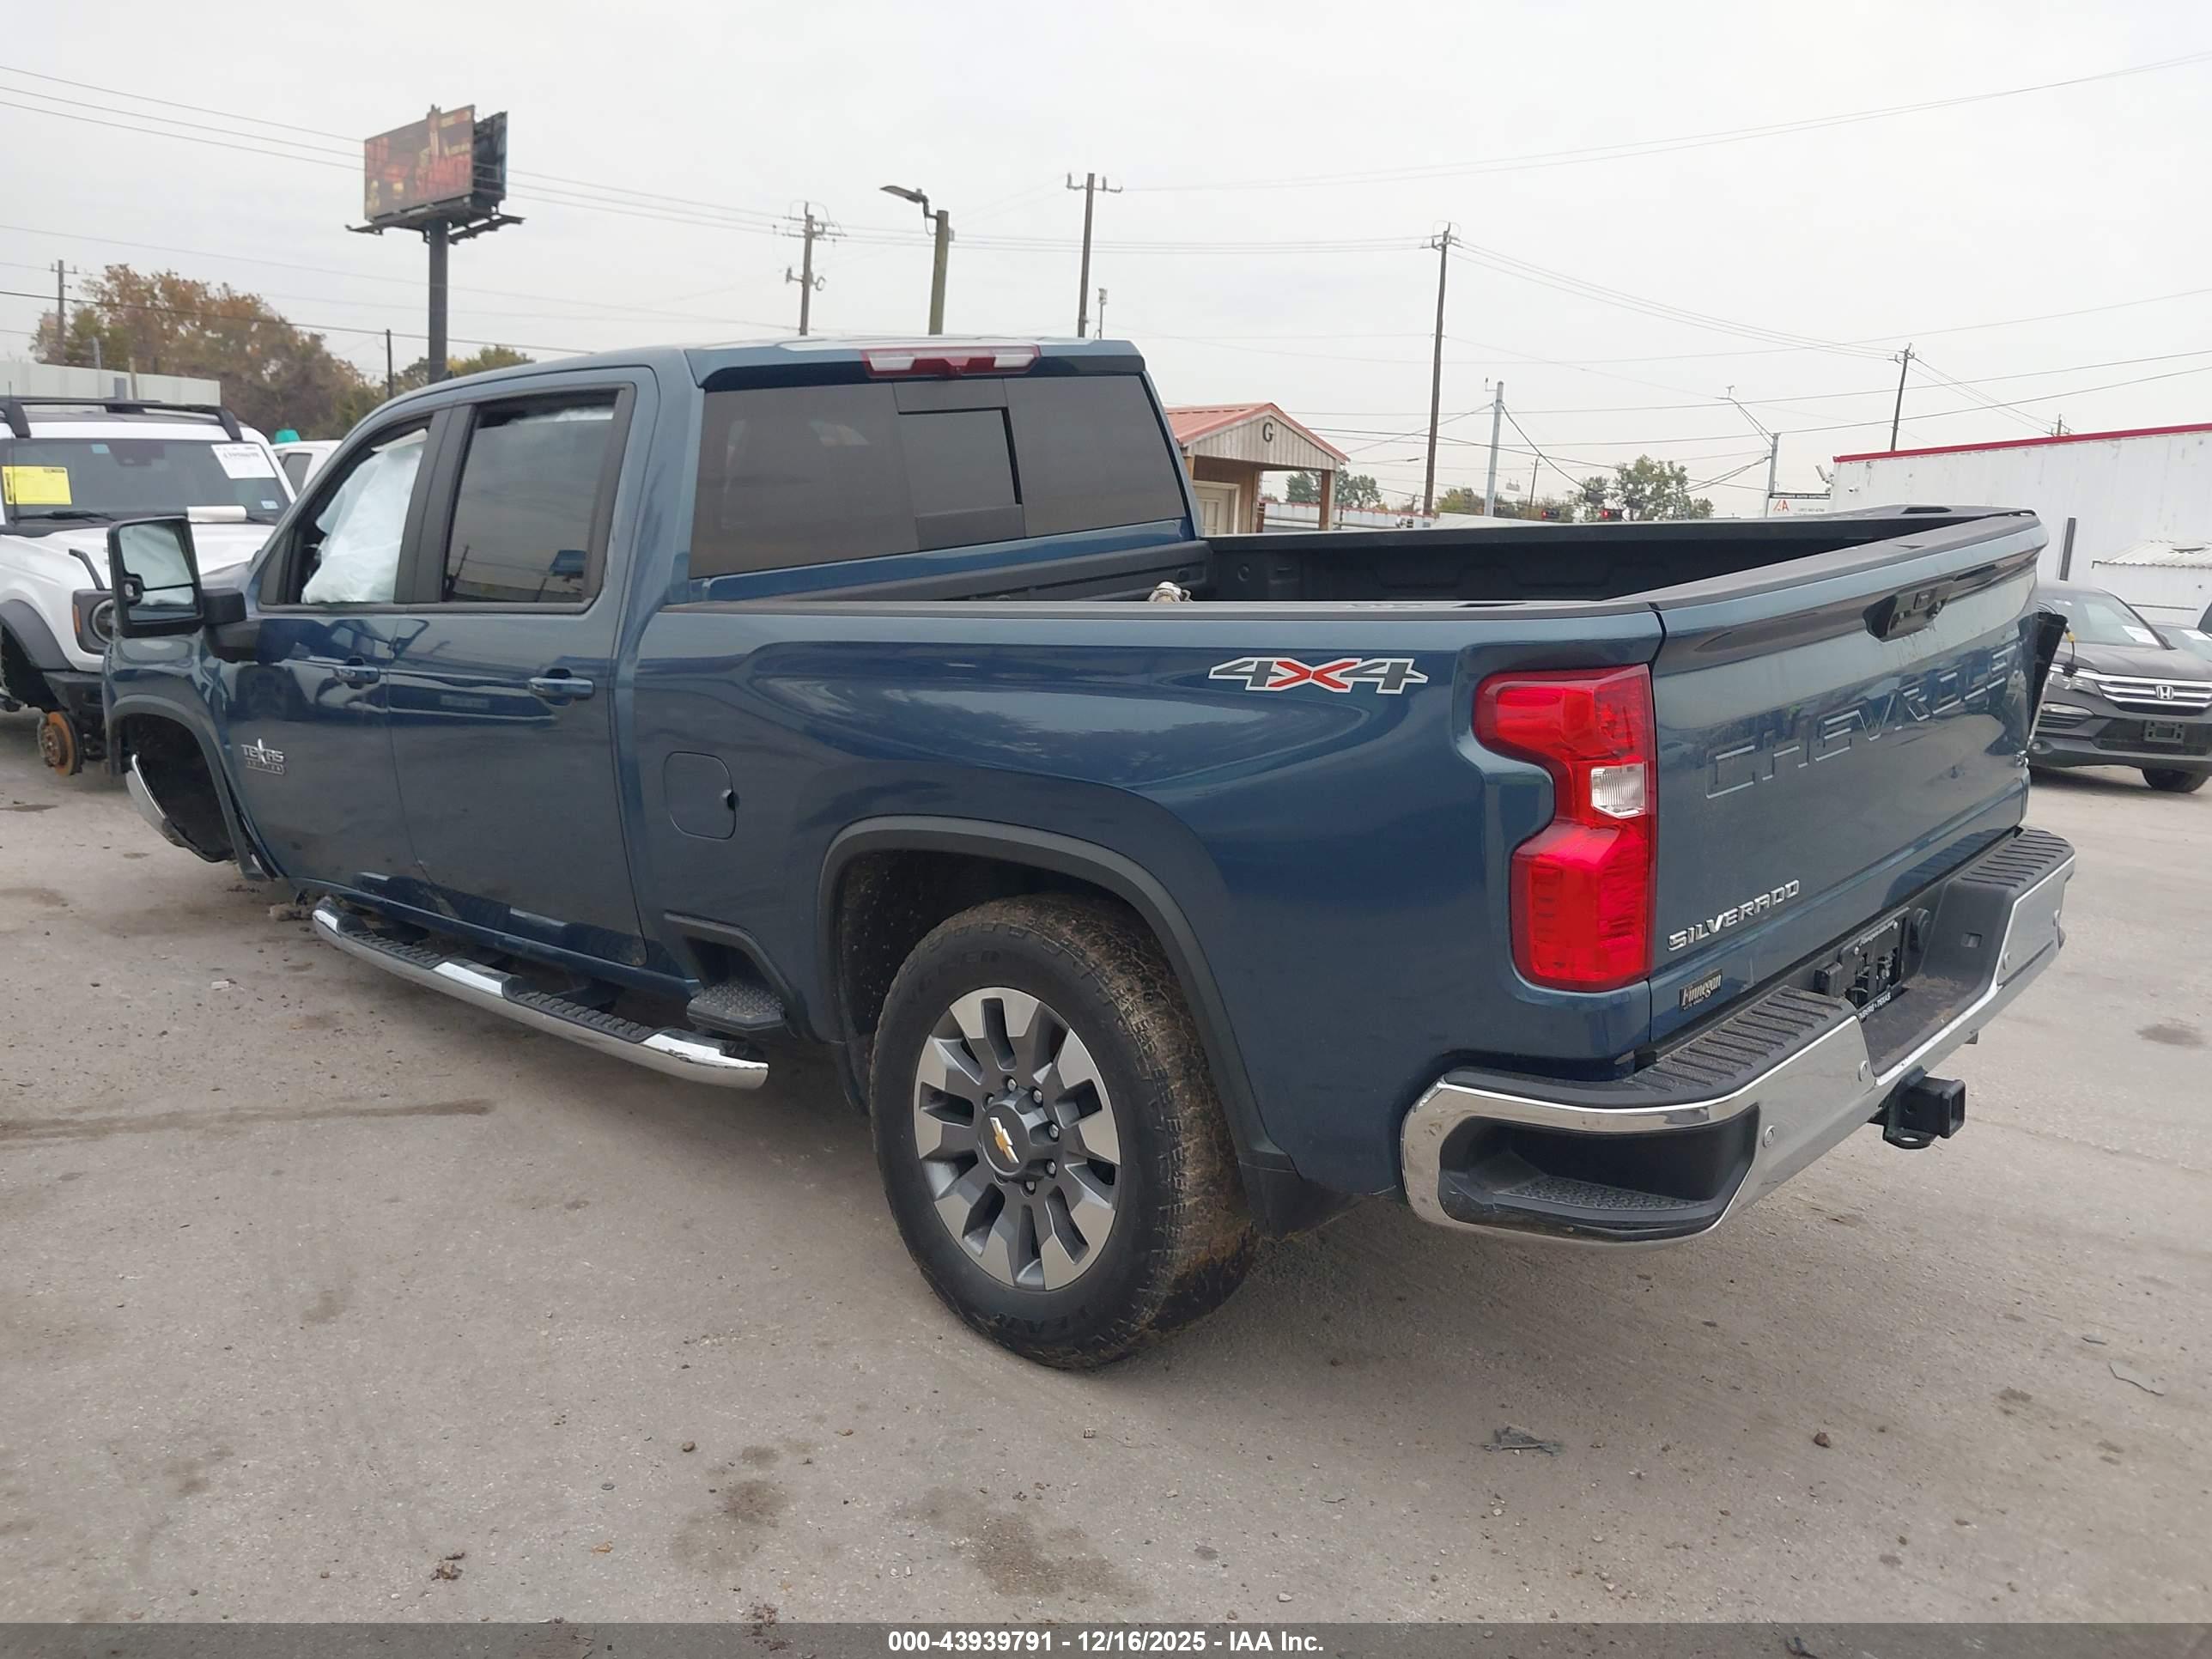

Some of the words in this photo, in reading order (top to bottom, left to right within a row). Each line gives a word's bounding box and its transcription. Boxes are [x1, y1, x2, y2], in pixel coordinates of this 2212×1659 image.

[1262, 422, 1274, 443] G
[240, 738, 284, 764] TEXAS
[1668, 879, 1800, 951] SILVERADO
[1681, 974, 1722, 1006] Finnegan
